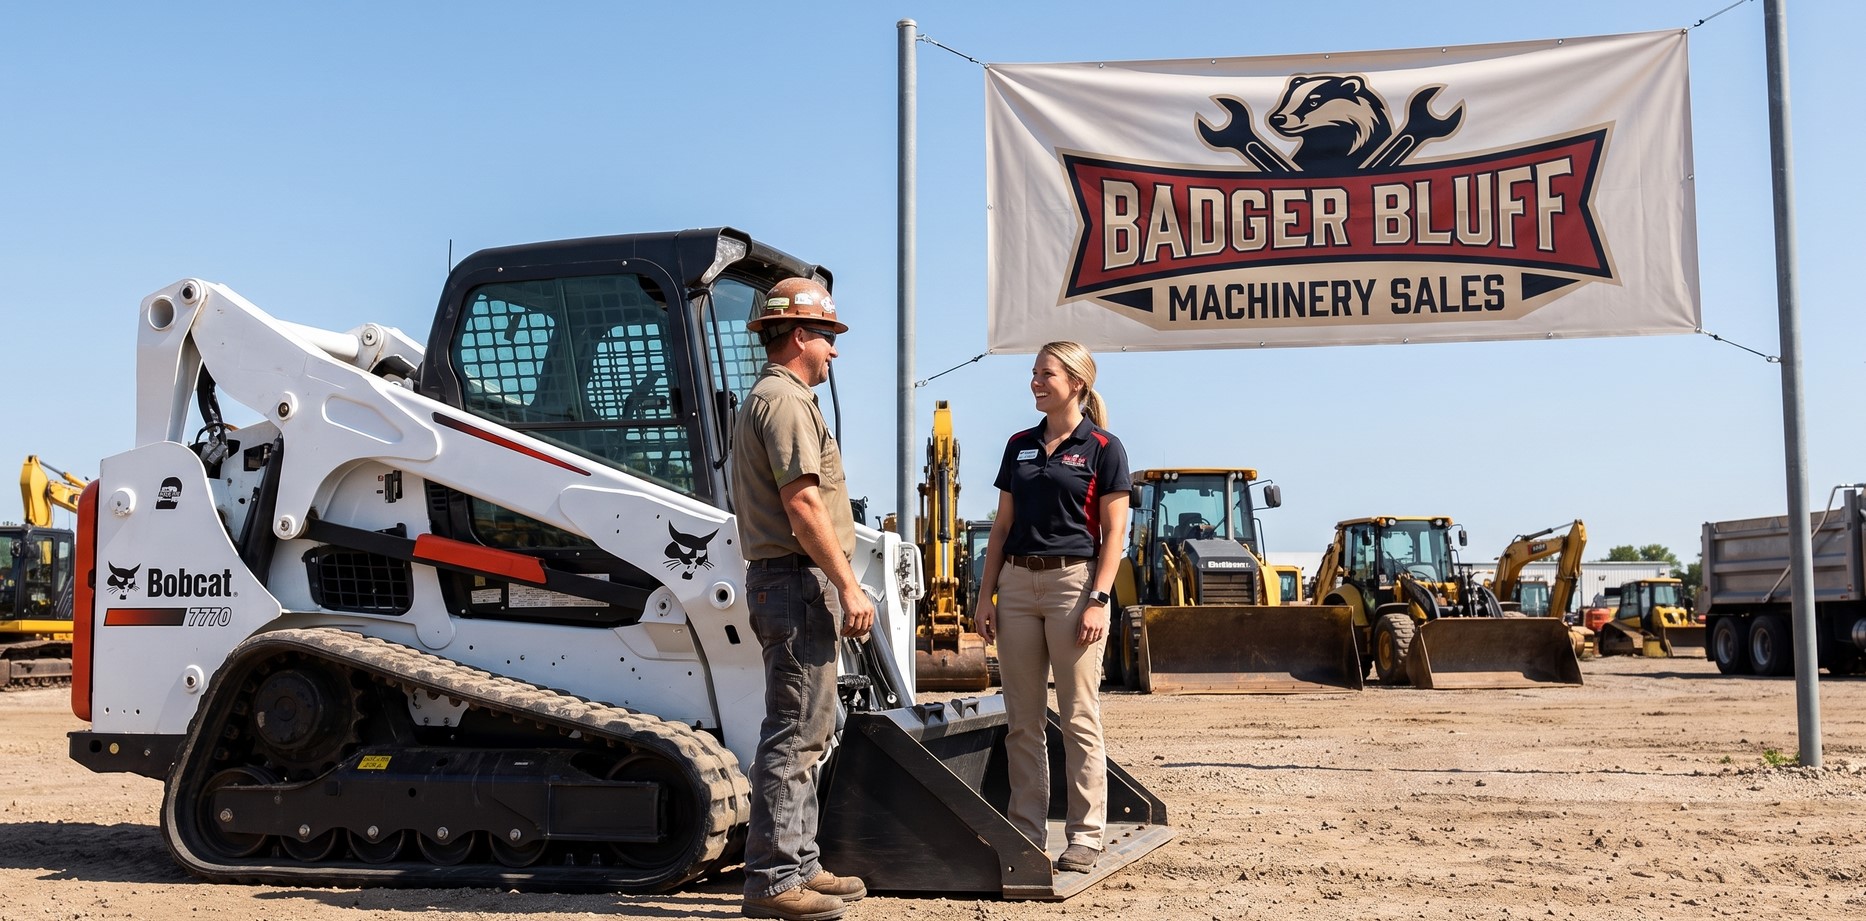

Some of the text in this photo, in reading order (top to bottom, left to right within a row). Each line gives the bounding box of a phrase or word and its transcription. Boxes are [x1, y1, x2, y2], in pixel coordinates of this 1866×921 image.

[1102, 158, 1572, 270] BADGER BLUFF
[1168, 273, 1505, 321] MACHINERY SALES
[148, 568, 232, 598] Bobcat
[188, 607, 231, 626] 7770
